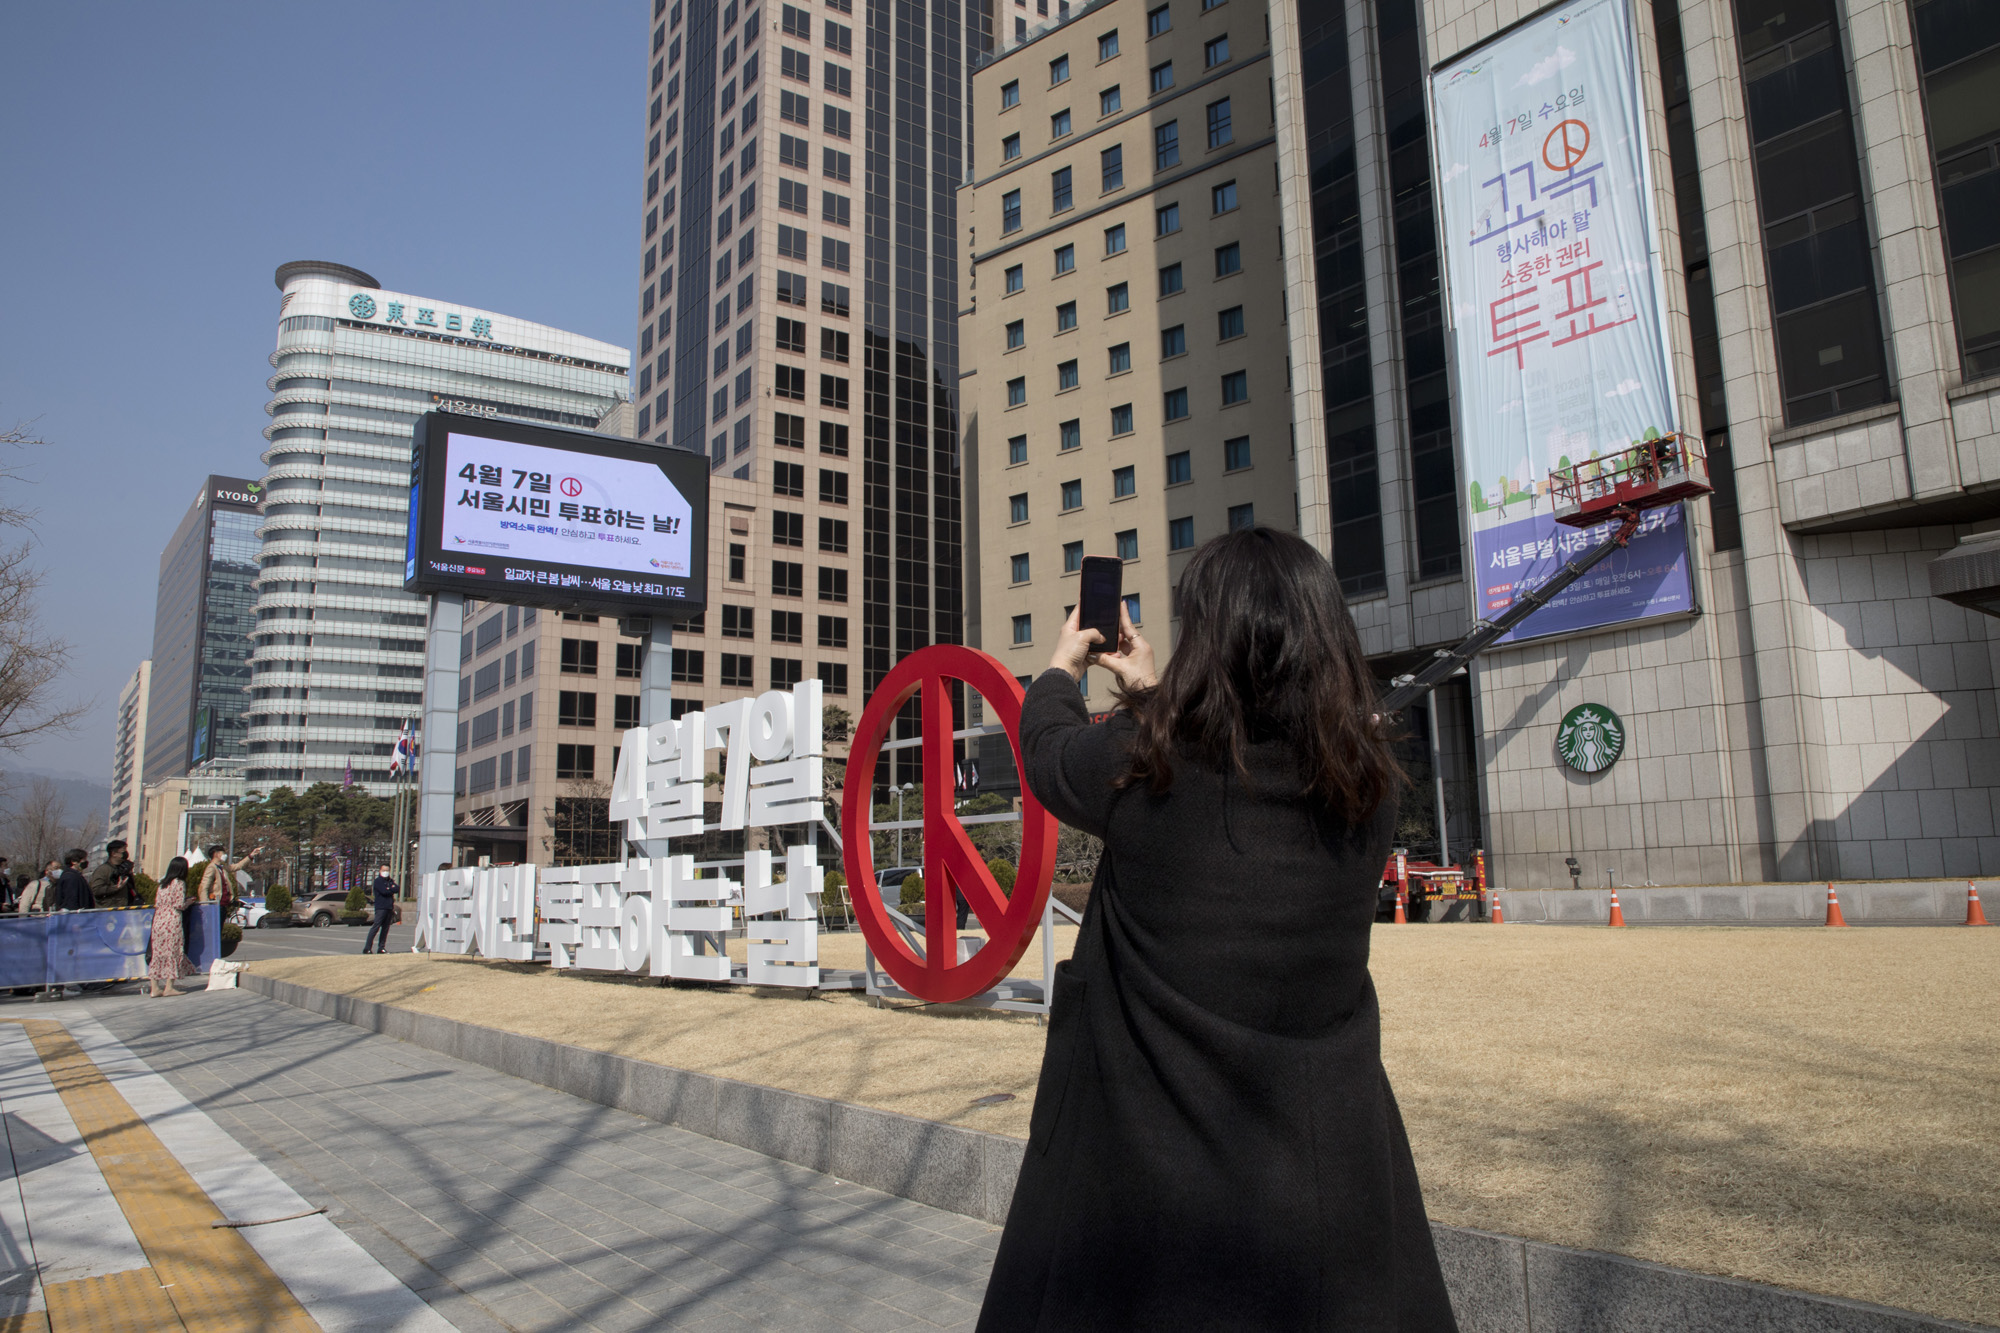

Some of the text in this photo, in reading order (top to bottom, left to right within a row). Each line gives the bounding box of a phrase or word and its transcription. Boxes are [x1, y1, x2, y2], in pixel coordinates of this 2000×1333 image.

[1479, 84, 1585, 148] 4월 7일 수요일
[1496, 209, 1591, 263] 행사해야 할
[1501, 238, 1590, 288] 소중한 권리
[1487, 260, 1608, 370] 투표
[438, 398, 498, 419] 서울신문
[217, 489, 259, 503] KYOBO
[458, 463, 551, 493] 4월 7일
[457, 489, 681, 534] 서울시민 투표하는 날!
[561, 527, 596, 540] 안심하고
[1490, 529, 1588, 568] 서울특별시장
[430, 561, 465, 573] 서울신문
[504, 567, 535, 583] 일교차
[536, 571, 548, 584] 큰
[548, 572, 559, 586] 봄
[612, 579, 632, 593] 오늘
[644, 583, 663, 596] 최고
[665, 586, 686, 598] 17도
[412, 844, 825, 987] 서울시민 투표하는 날
